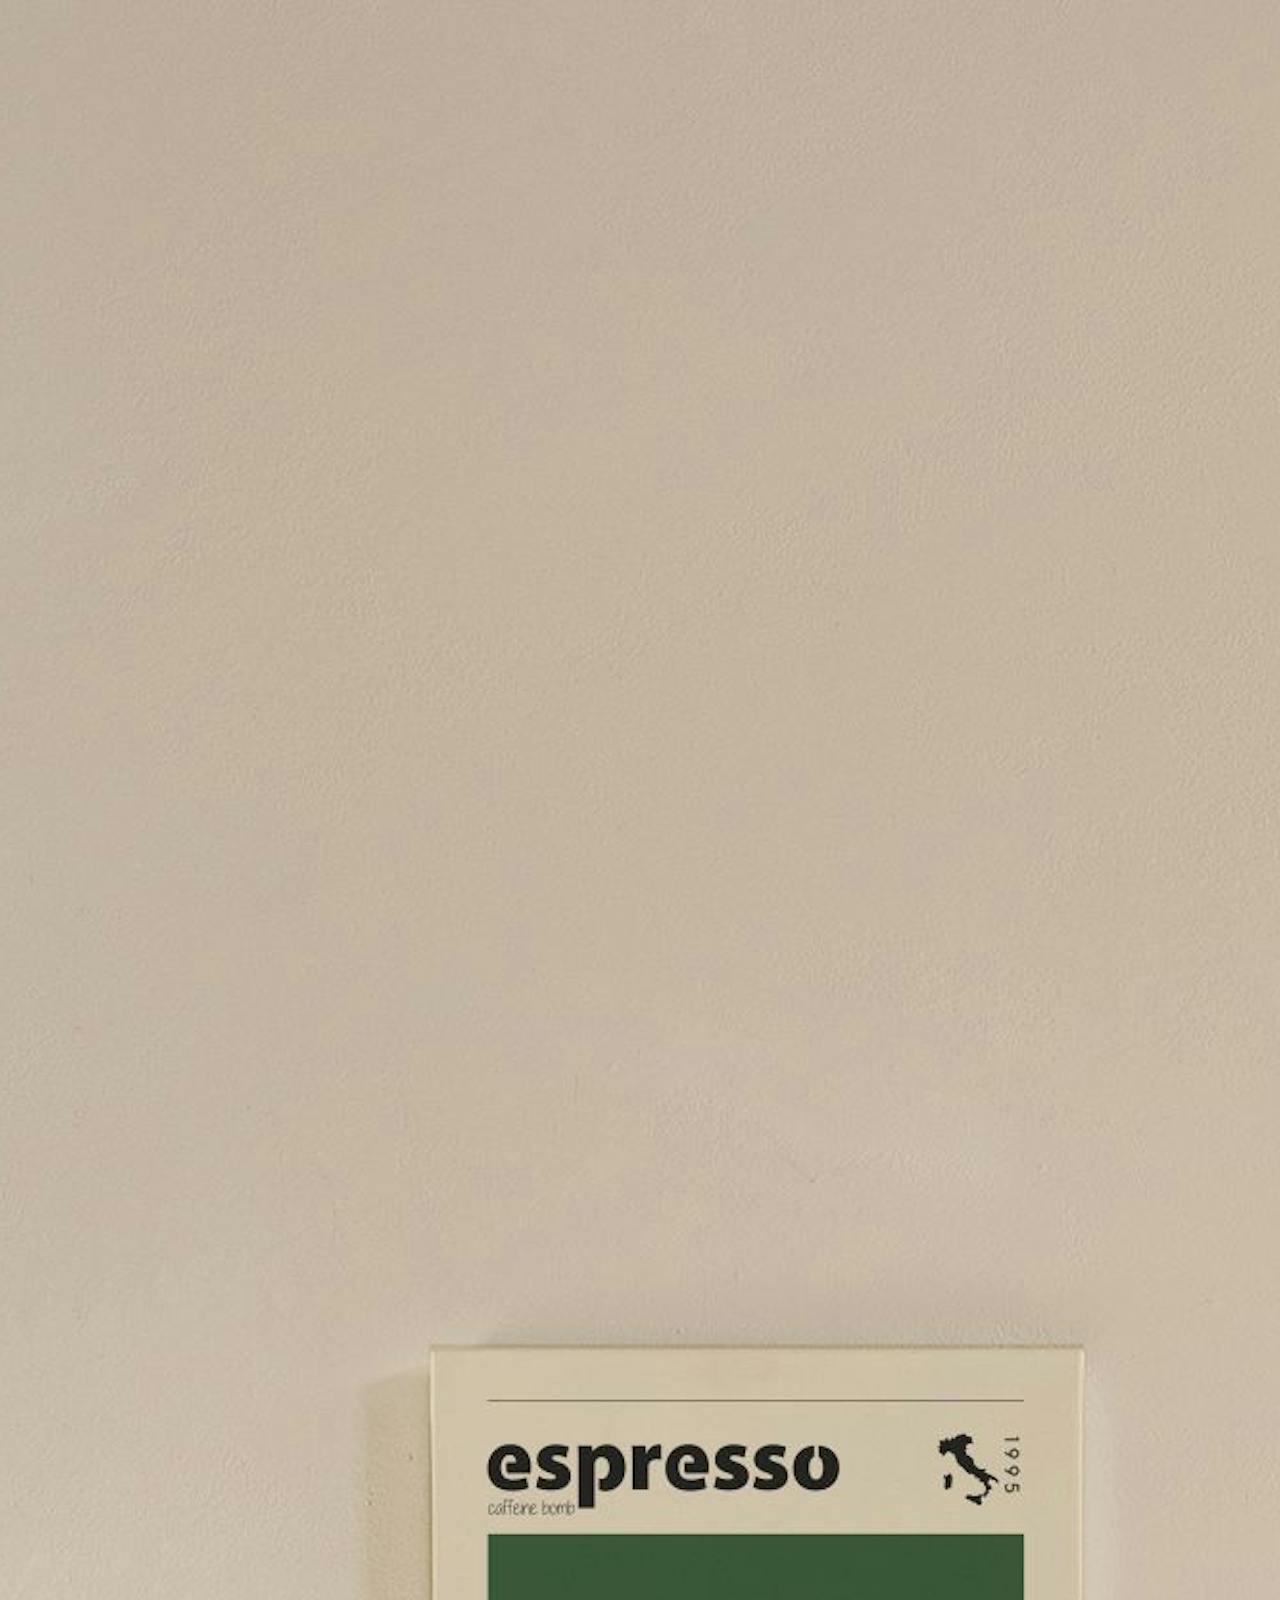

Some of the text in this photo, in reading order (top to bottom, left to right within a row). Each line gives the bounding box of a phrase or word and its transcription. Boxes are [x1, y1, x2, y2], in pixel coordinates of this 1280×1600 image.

[487, 1443, 840, 1509] espresso
[1003, 1436, 1021, 1494] 1995
[487, 1499, 576, 1516] caffeine bomb
